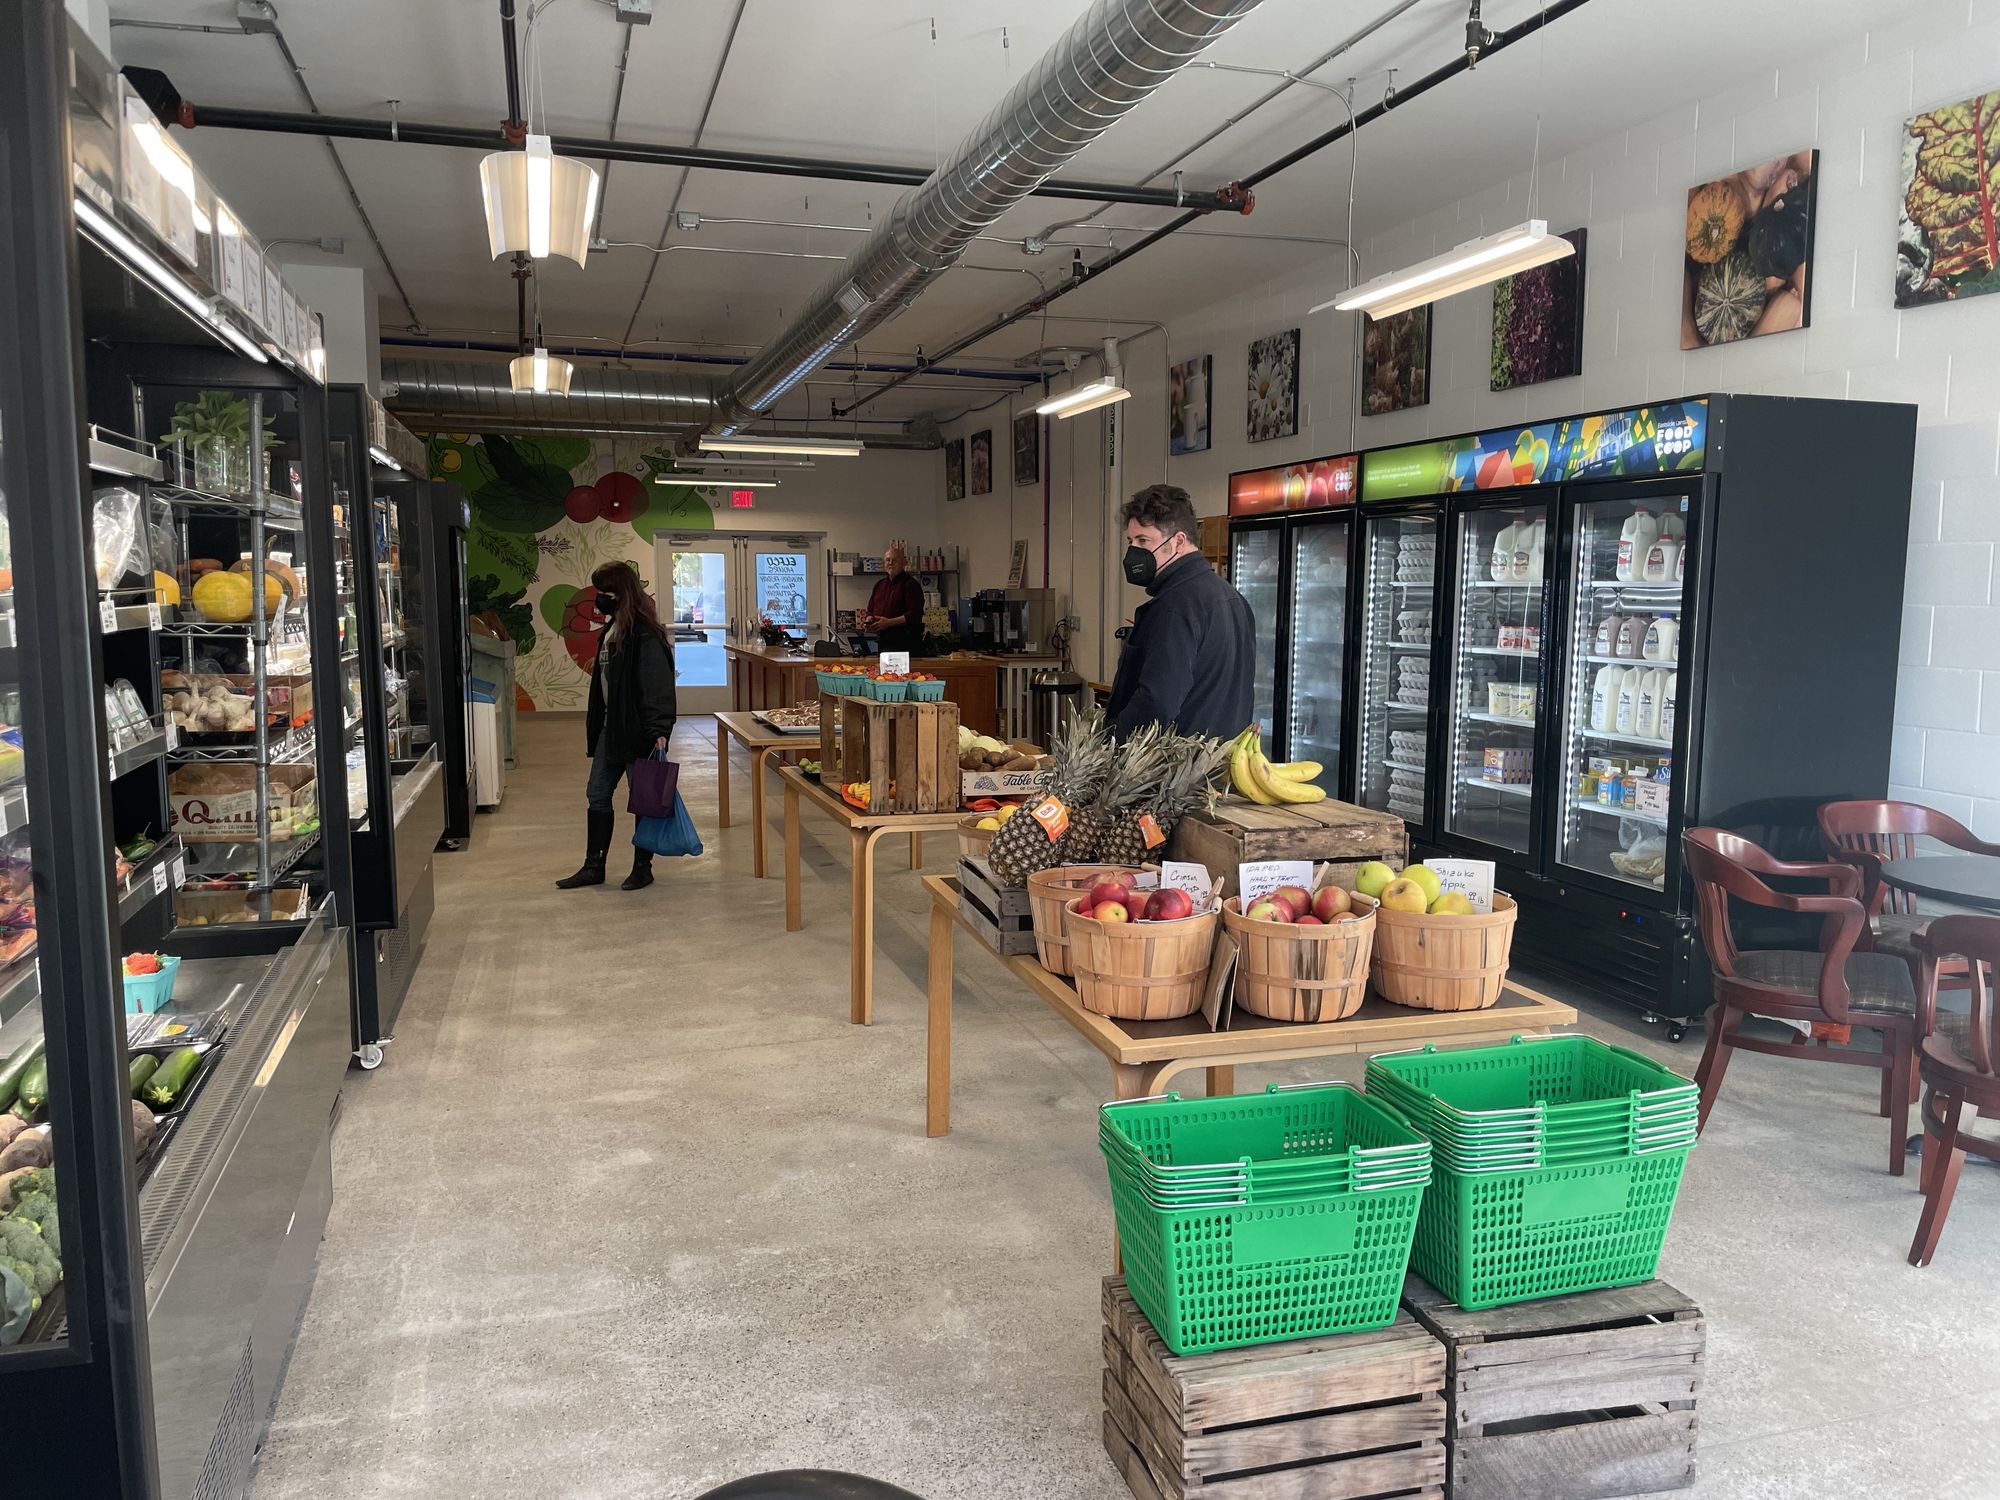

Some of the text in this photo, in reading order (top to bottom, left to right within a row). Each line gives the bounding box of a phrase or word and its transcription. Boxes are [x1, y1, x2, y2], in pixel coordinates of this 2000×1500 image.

[1657, 426, 1693, 442] FOOD
[1335, 471, 1353, 482] FOOD
[732, 491, 753, 507] EXIT
[1003, 773, 1032, 786] Table
[1170, 870, 1197, 881] Crimson
[1249, 875, 1268, 884] HARD
[1250, 884, 1275, 892] GREAT
[1440, 879, 1466, 891] Apple
